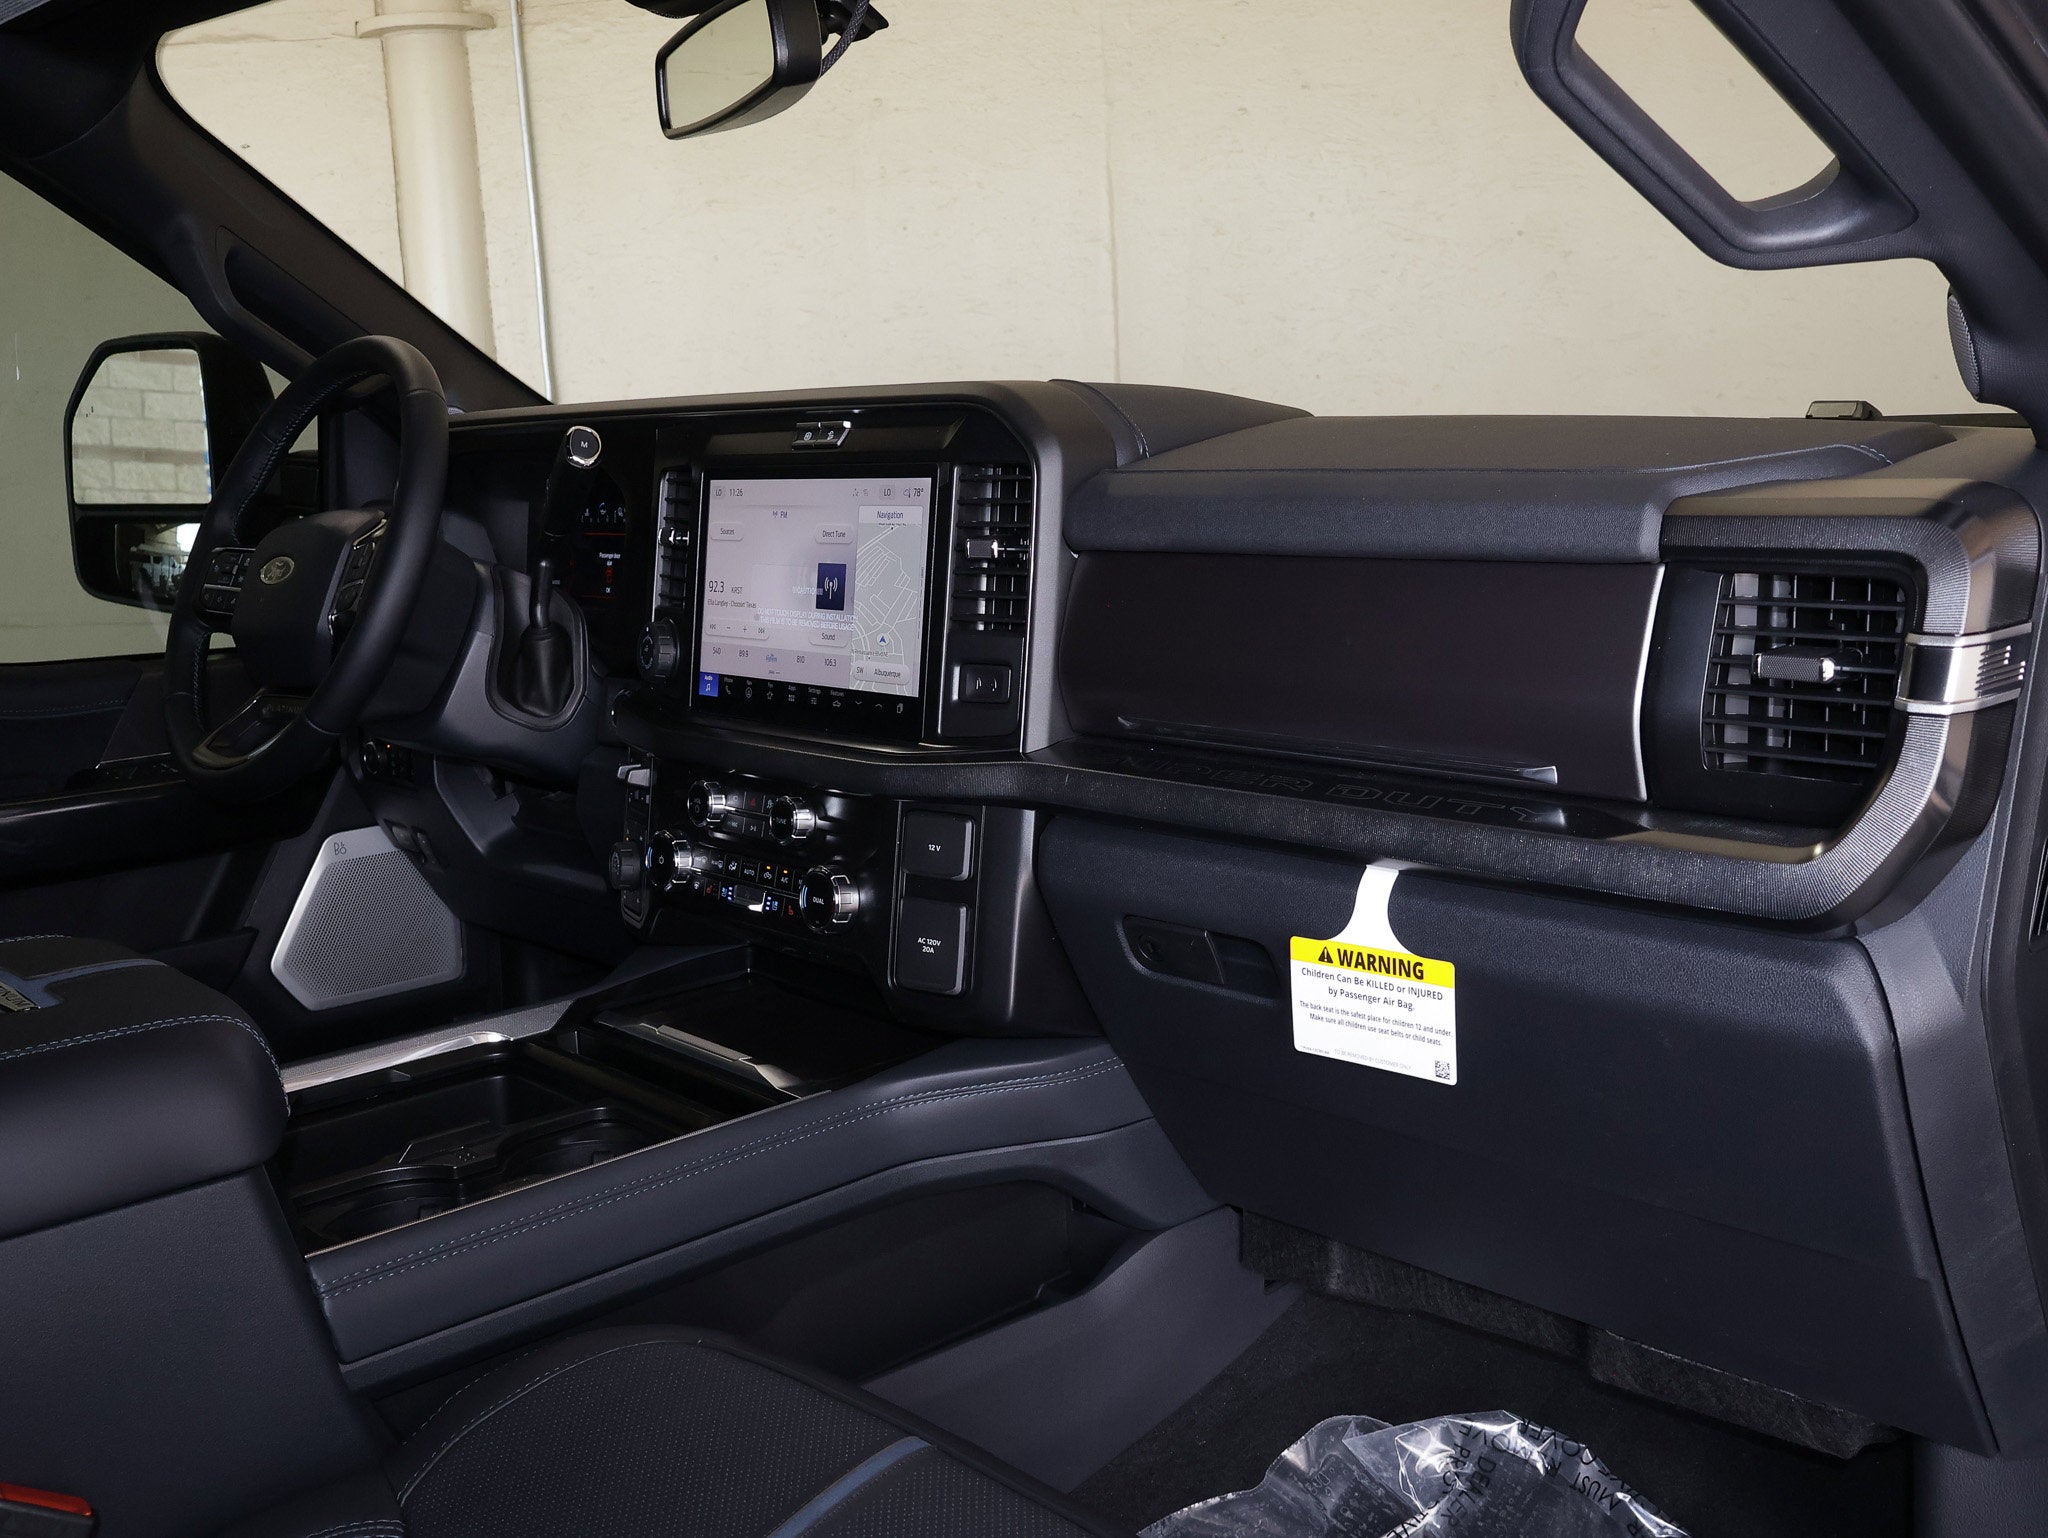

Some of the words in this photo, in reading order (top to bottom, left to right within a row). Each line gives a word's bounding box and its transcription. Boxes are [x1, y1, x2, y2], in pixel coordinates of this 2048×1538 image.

[580, 440, 588, 449] M
[883, 488, 891, 497] LO
[876, 511, 904, 521] Navigation
[822, 530, 835, 538] Direct
[835, 530, 846, 538] Tune
[708, 580, 724, 593] 92.3
[821, 633, 836, 641] Sound
[874, 668, 901, 679] Albuquerque
[812, 895, 825, 905] DUAL
[917, 937, 926, 945] AC
[926, 938, 941, 947] 120V
[922, 945, 934, 954] 20A
[1337, 948, 1424, 980] WARNING
[1301, 967, 1334, 981] Children
[1337, 973, 1352, 984] Can
[1354, 976, 1364, 986] Be
[1366, 979, 1395, 991] KILLED
[1408, 986, 1443, 1000] INJURED
[1328, 986, 1338, 997] by
[1340, 988, 1381, 1005] Passenger
[1383, 997, 1395, 1006] Air
[1397, 999, 1415, 1012] Bag.
[1299, 1000, 1309, 1009] The
[1310, 1002, 1321, 1011] back
[1323, 1005, 1334, 1013] seat
[1341, 1009, 1349, 1017] the
[1350, 1010, 1366, 1019] safest
[1367, 1013, 1381, 1023] place
[1382, 1016, 1391, 1024] for
[1392, 1018, 1414, 1029] children
[1415, 1023, 1422, 1031] 12
[1423, 1025, 1434, 1033] and
[1309, 1013, 1324, 1022] Make
[1325, 1016, 1336, 1025] sure
[1345, 1020, 1366, 1030] children
[1367, 1025, 1377, 1033] use
[1378, 1027, 1389, 1036] seat
[1390, 1028, 1404, 1038] belts
[1412, 1033, 1426, 1043] child
[1569, 1472, 1621, 1511] MUST
